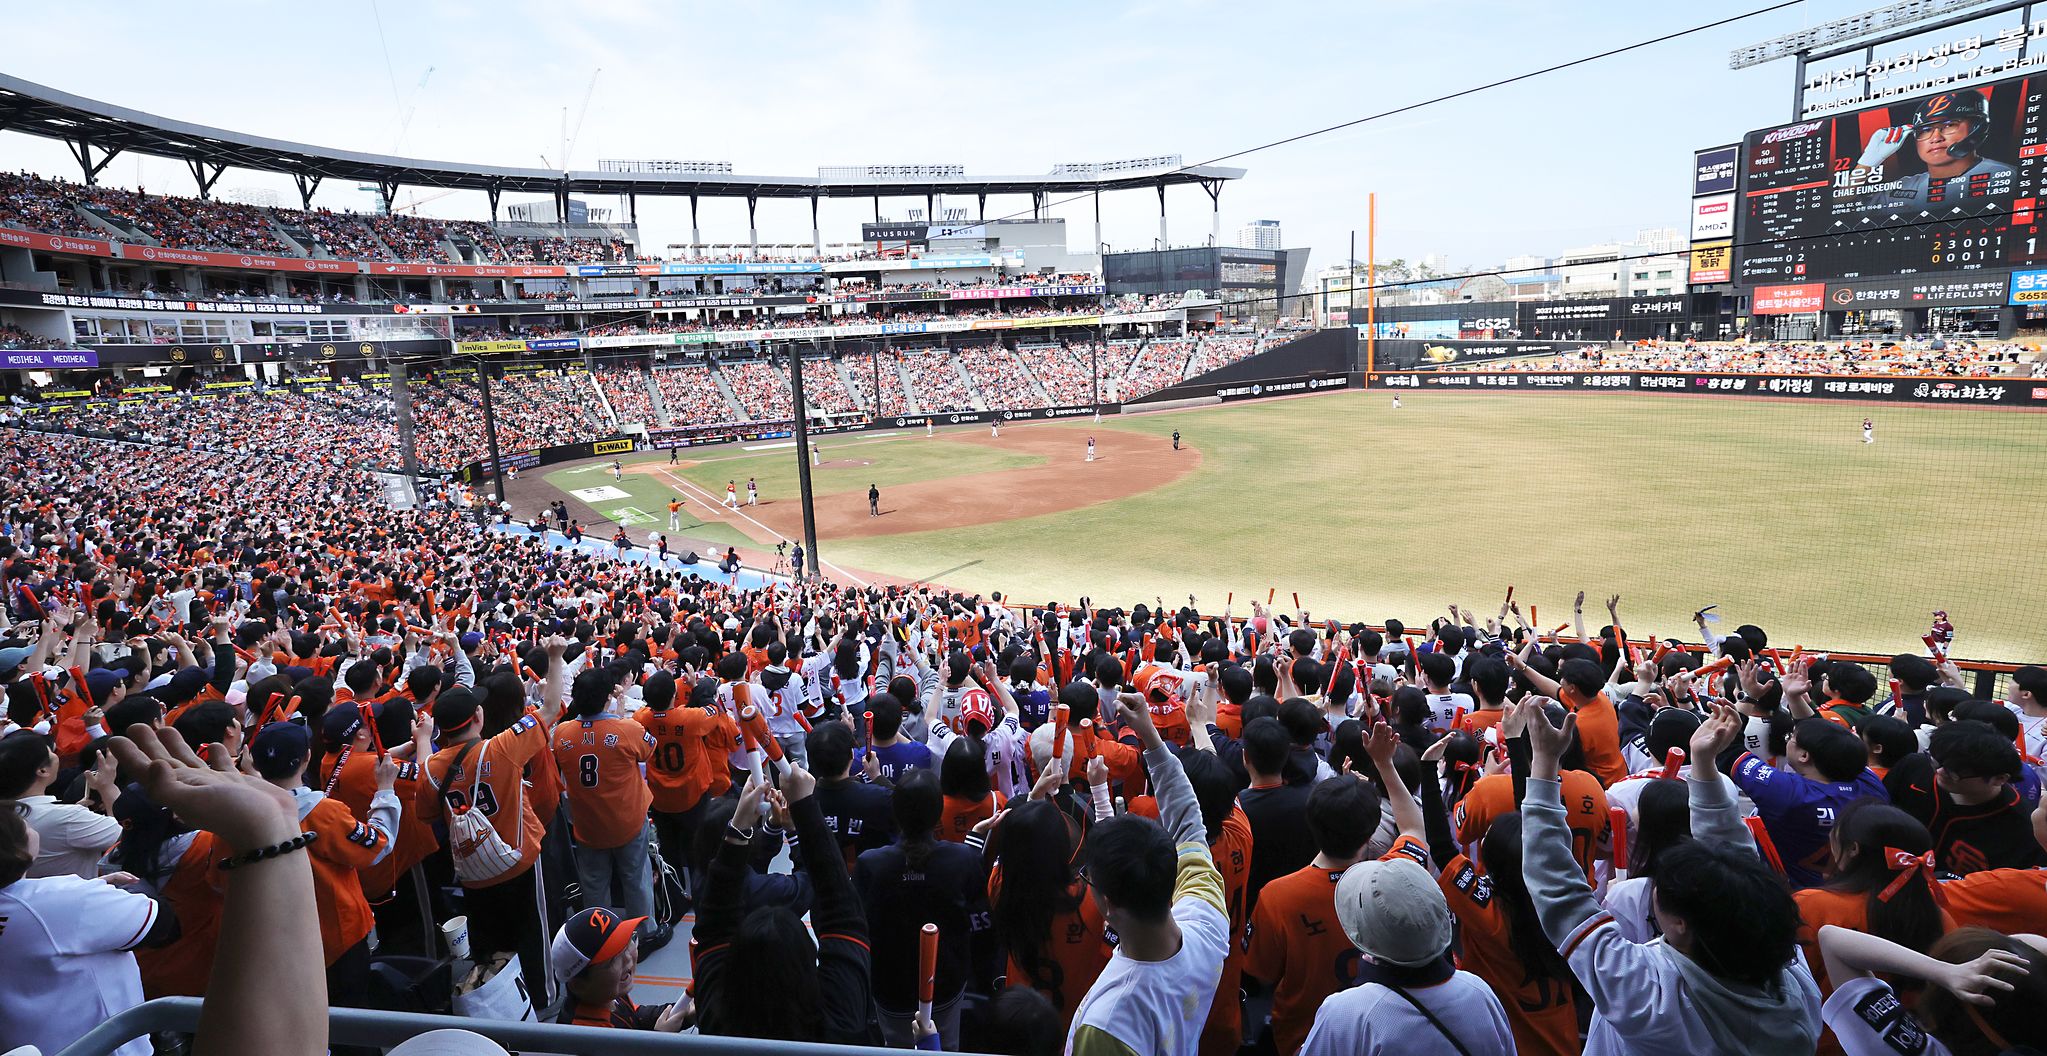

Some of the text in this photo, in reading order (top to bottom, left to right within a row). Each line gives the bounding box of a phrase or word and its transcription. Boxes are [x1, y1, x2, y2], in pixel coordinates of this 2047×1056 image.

[1811, 66, 1856, 92] 대전
[1866, 35, 1982, 82] 한화생명
[1808, 94, 1865, 114] Daejeon
[1869, 75, 1949, 100] Hanwha
[1954, 63, 1995, 83] Life
[2029, 94, 2042, 102] CF
[2027, 105, 2041, 113] RF
[2026, 116, 2039, 124] LF
[1762, 121, 1823, 144] KIWOOM
[1761, 149, 1770, 157] 50
[1834, 157, 1851, 171] 22
[1832, 164, 1884, 188] 채은성
[1992, 170, 2012, 179] .600
[1948, 177, 1966, 185] .500
[1987, 179, 2011, 187] 1.250
[1832, 180, 1903, 198] CHAE EUNSEONG
[1986, 187, 2010, 195] 1.850
[1700, 204, 1727, 213] Lenovo
[1698, 223, 1720, 231] AMD
[2029, 226, 2037, 234] B
[1785, 254, 1793, 262] 0
[1797, 253, 1804, 261] 2
[1933, 241, 1941, 250] 2
[1947, 240, 1956, 249] 3
[1963, 238, 1972, 248] 0
[1979, 237, 1988, 247] 0
[2026, 237, 2036, 255] 1
[1784, 265, 1792, 274] 0
[1796, 264, 1804, 273] 0
[1931, 254, 1940, 263] 0
[1946, 253, 1955, 262] 0
[1961, 252, 1971, 261] 0
[1947, 283, 1970, 291] 콘텐츠
[1972, 282, 2003, 290] 큐레이션
[1855, 289, 1900, 301] 한화생명
[1927, 289, 2003, 300] LIFEPLUS TV
[1475, 318, 1511, 330] GS25
[8, 355, 88, 364] MEDIHEAL MEDIHEAL
[1640, 376, 1687, 388] 한남대학교
[579, 753, 599, 788] 8
